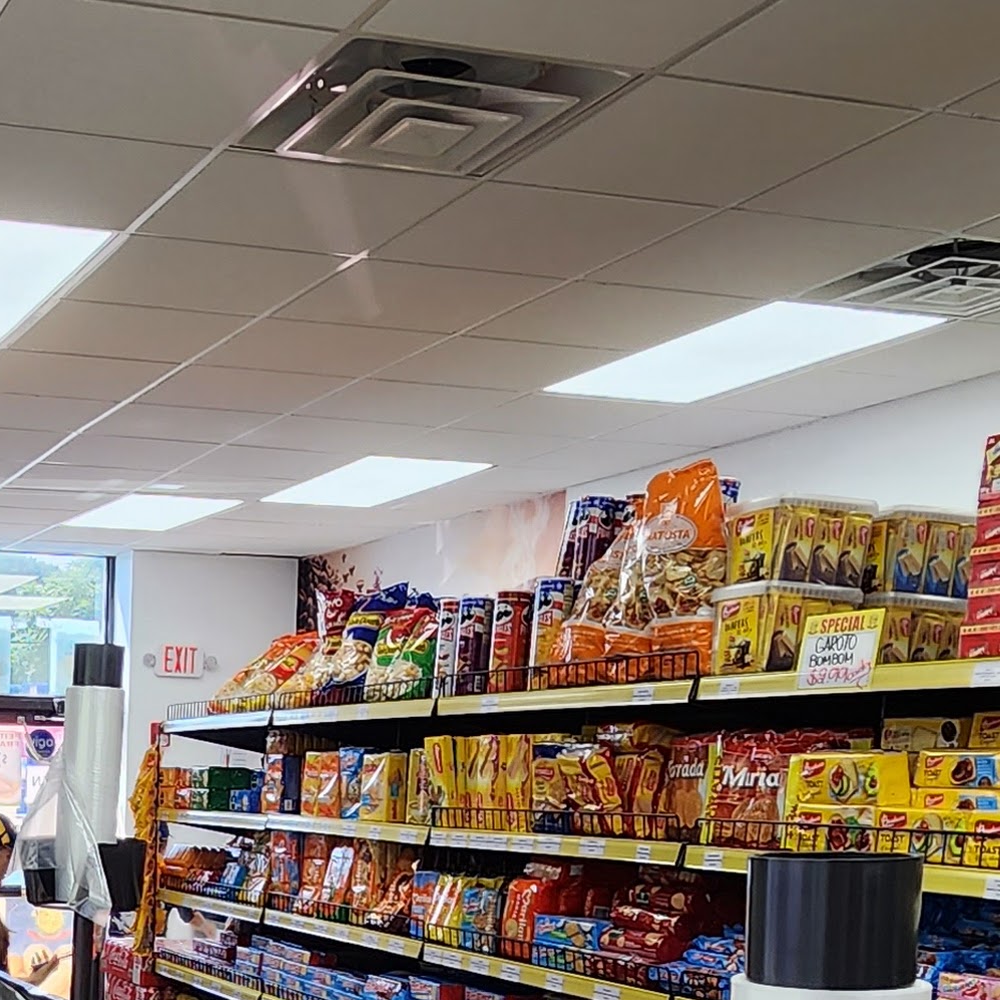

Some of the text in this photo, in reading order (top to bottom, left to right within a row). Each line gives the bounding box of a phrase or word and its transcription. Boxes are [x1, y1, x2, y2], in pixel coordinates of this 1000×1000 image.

[820, 614, 866, 635] SPECIAL
[815, 633, 858, 654] GAROTO
[164, 645, 198, 674] EXIT
[808, 652, 854, 668] BOMBOM
